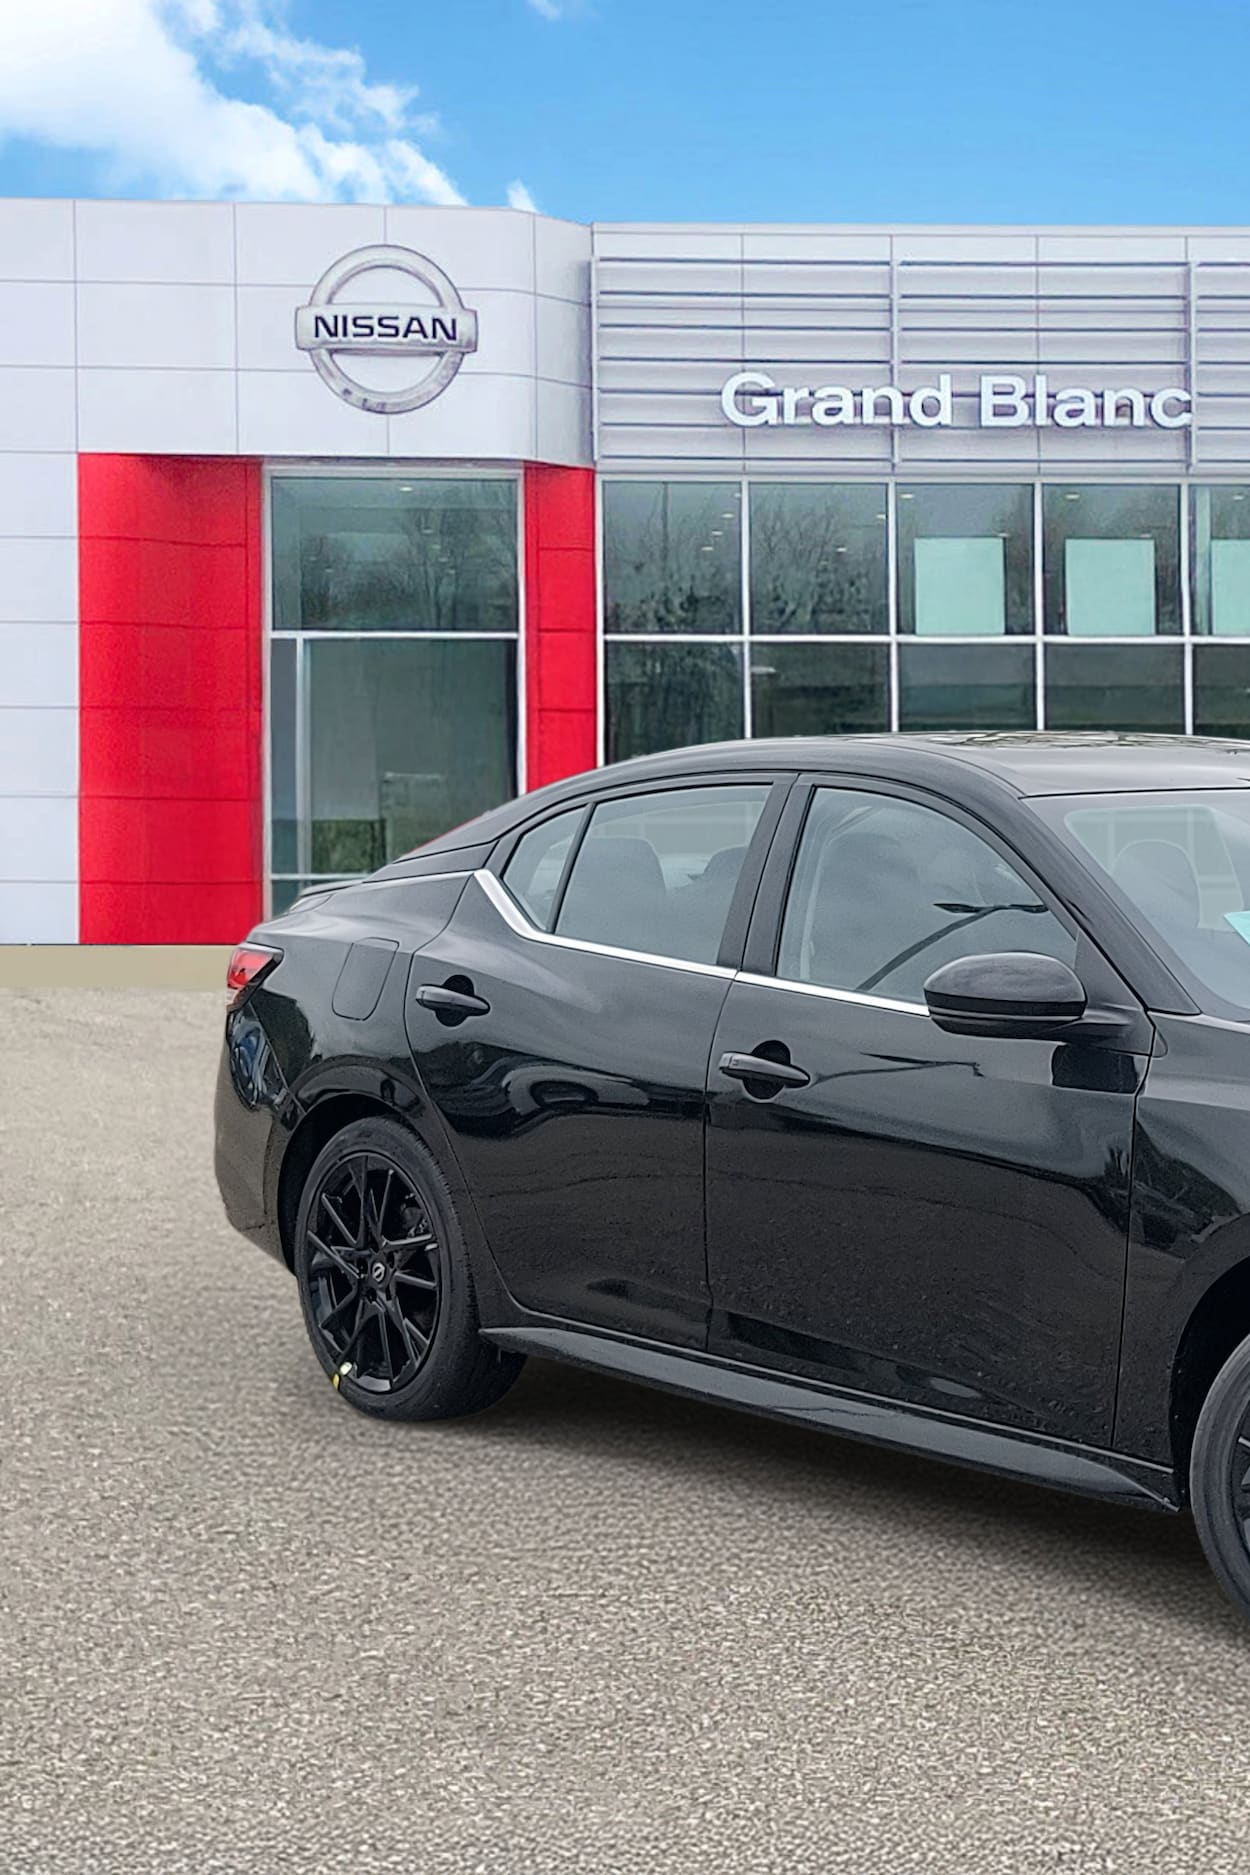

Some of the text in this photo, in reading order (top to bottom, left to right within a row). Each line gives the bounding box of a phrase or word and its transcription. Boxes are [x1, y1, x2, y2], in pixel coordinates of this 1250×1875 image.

[314, 314, 457, 342] NISSAN
[721, 371, 1193, 428] Grand Blanc
